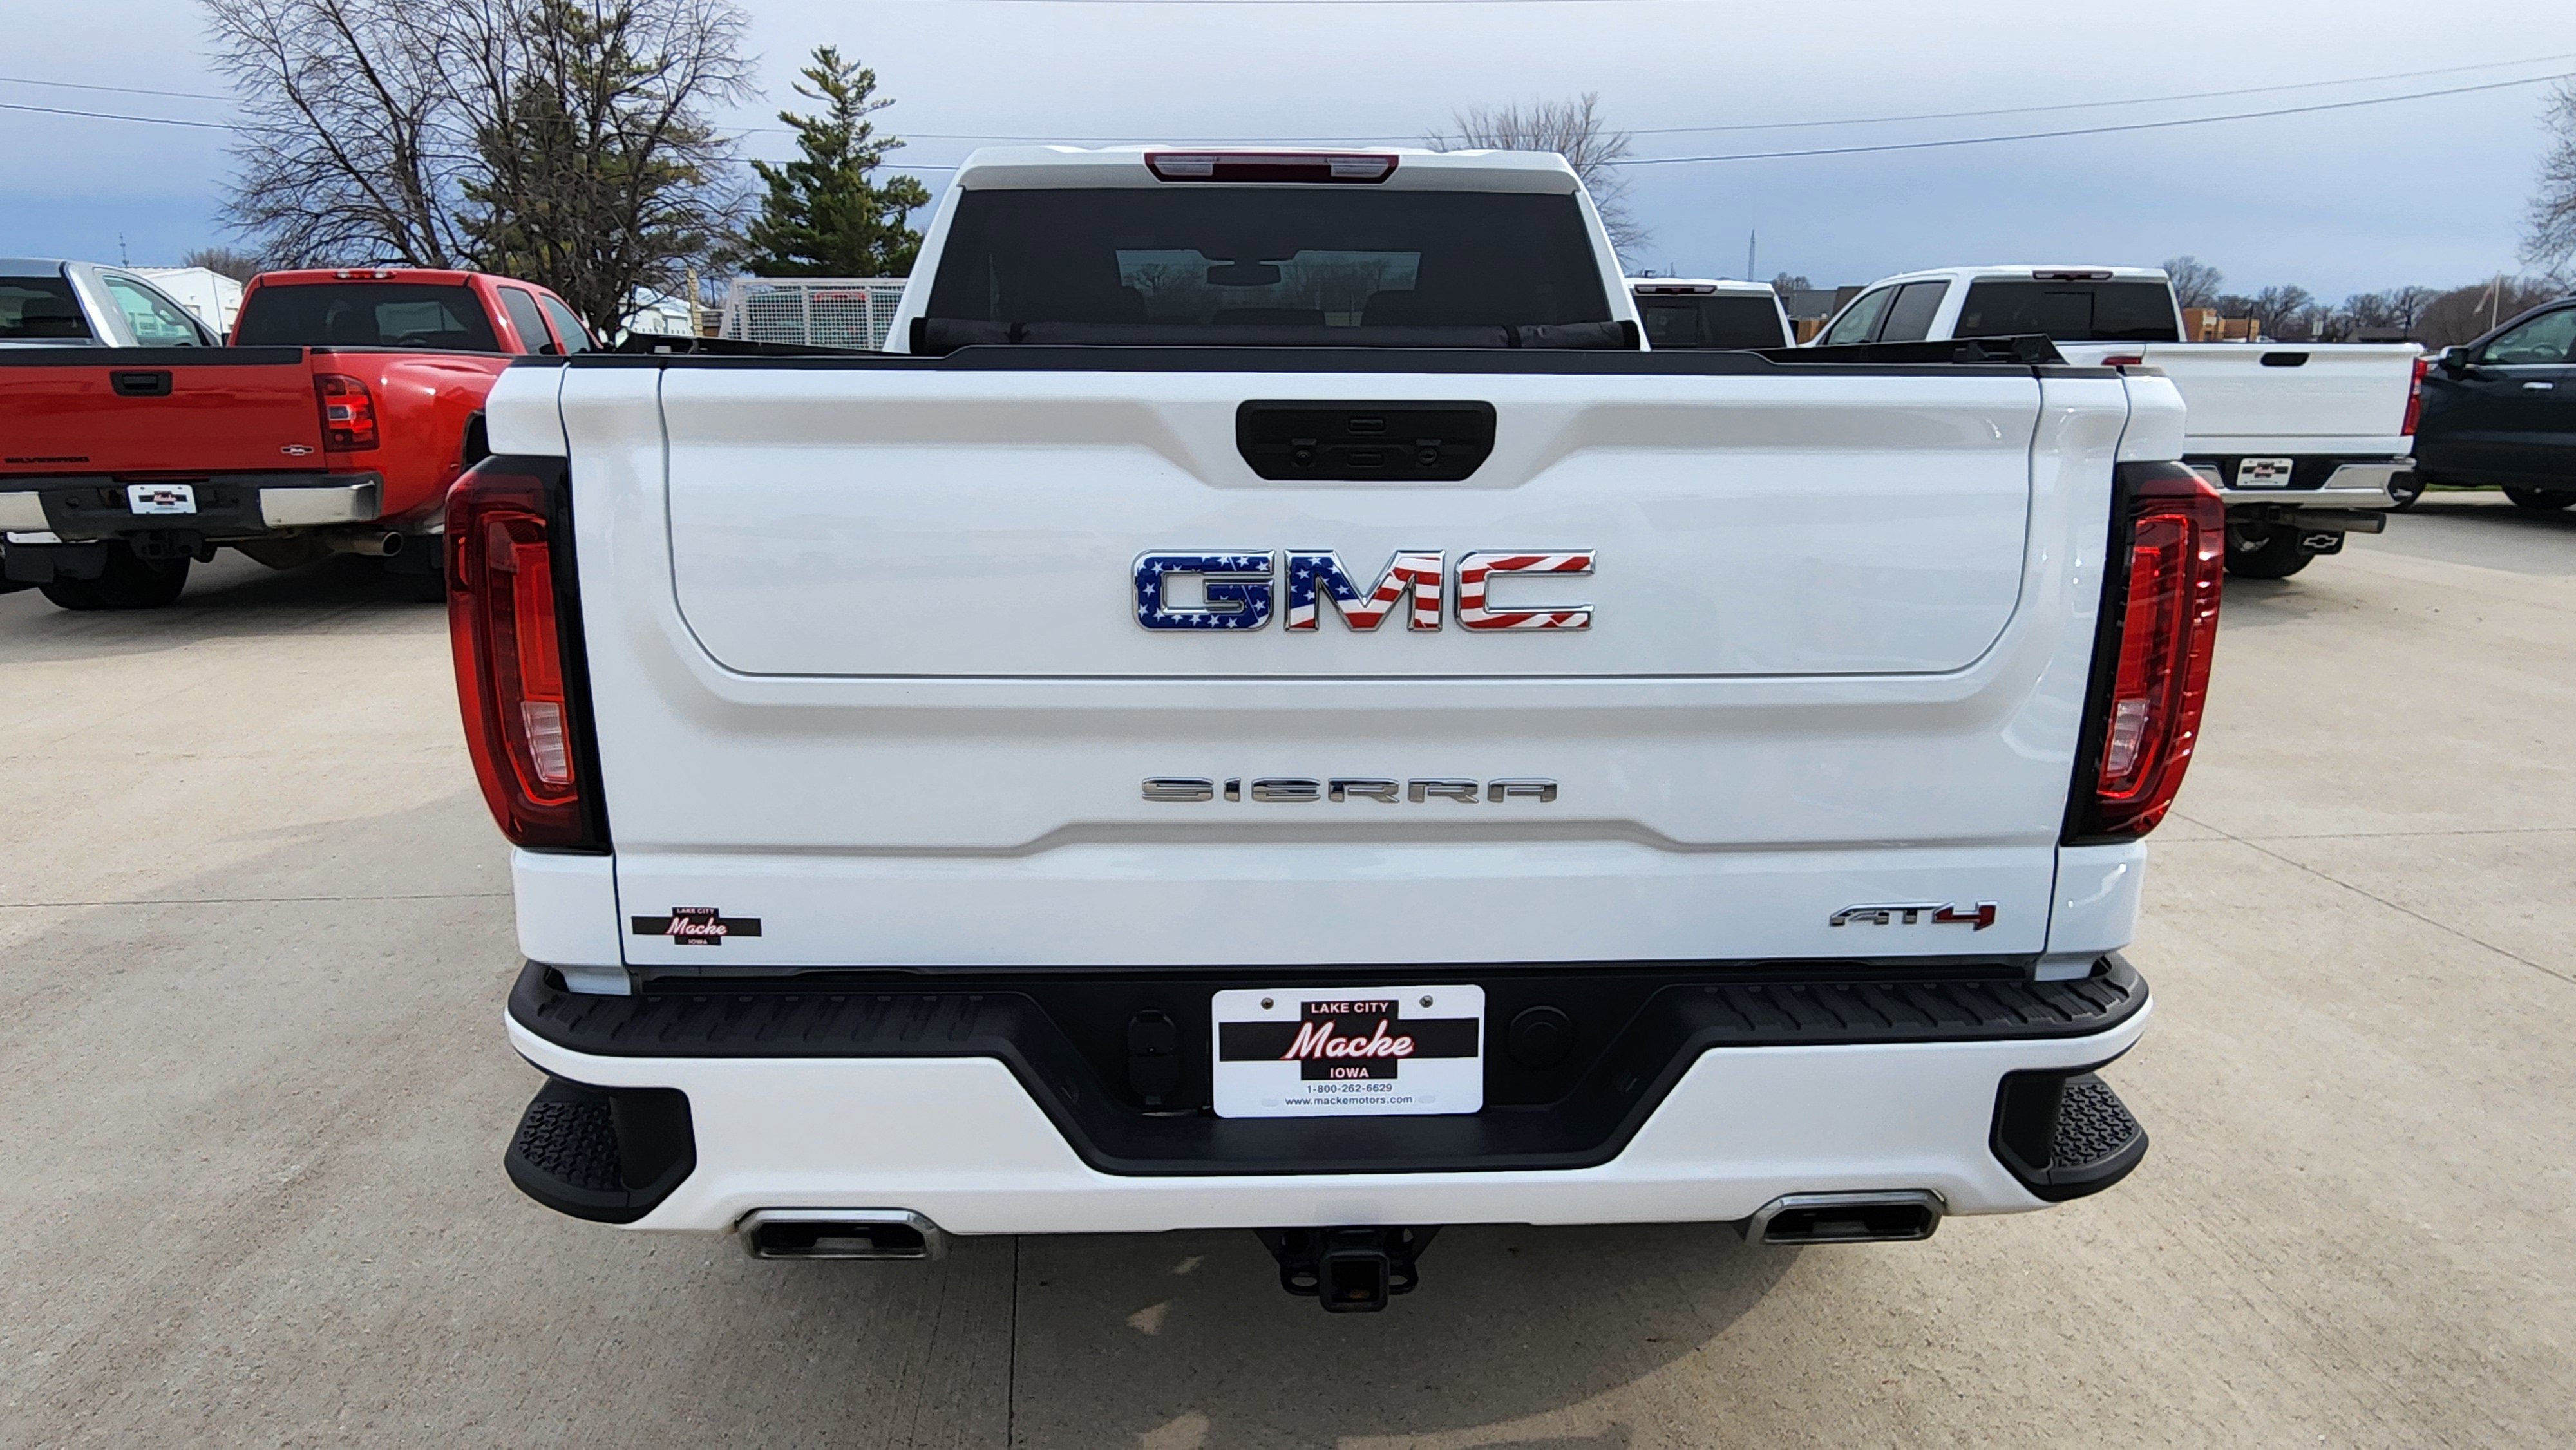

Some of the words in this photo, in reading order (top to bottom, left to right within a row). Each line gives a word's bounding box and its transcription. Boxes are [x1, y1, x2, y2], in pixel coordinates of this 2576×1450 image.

[1131, 549, 1596, 632] GMC
[1141, 777, 1560, 804] SIERRA
[1829, 899, 1999, 931] AT4
[665, 916, 728, 936] Macke
[1311, 1003, 1350, 1014] LAKE
[1353, 1002, 1389, 1013] CITY
[1279, 1018, 1415, 1060] Macke
[1330, 1067, 1370, 1078] IOWA
[1307, 1083, 1393, 1093] 1-800-262-6629
[1285, 1095, 1414, 1106] www.mackemotors.com
